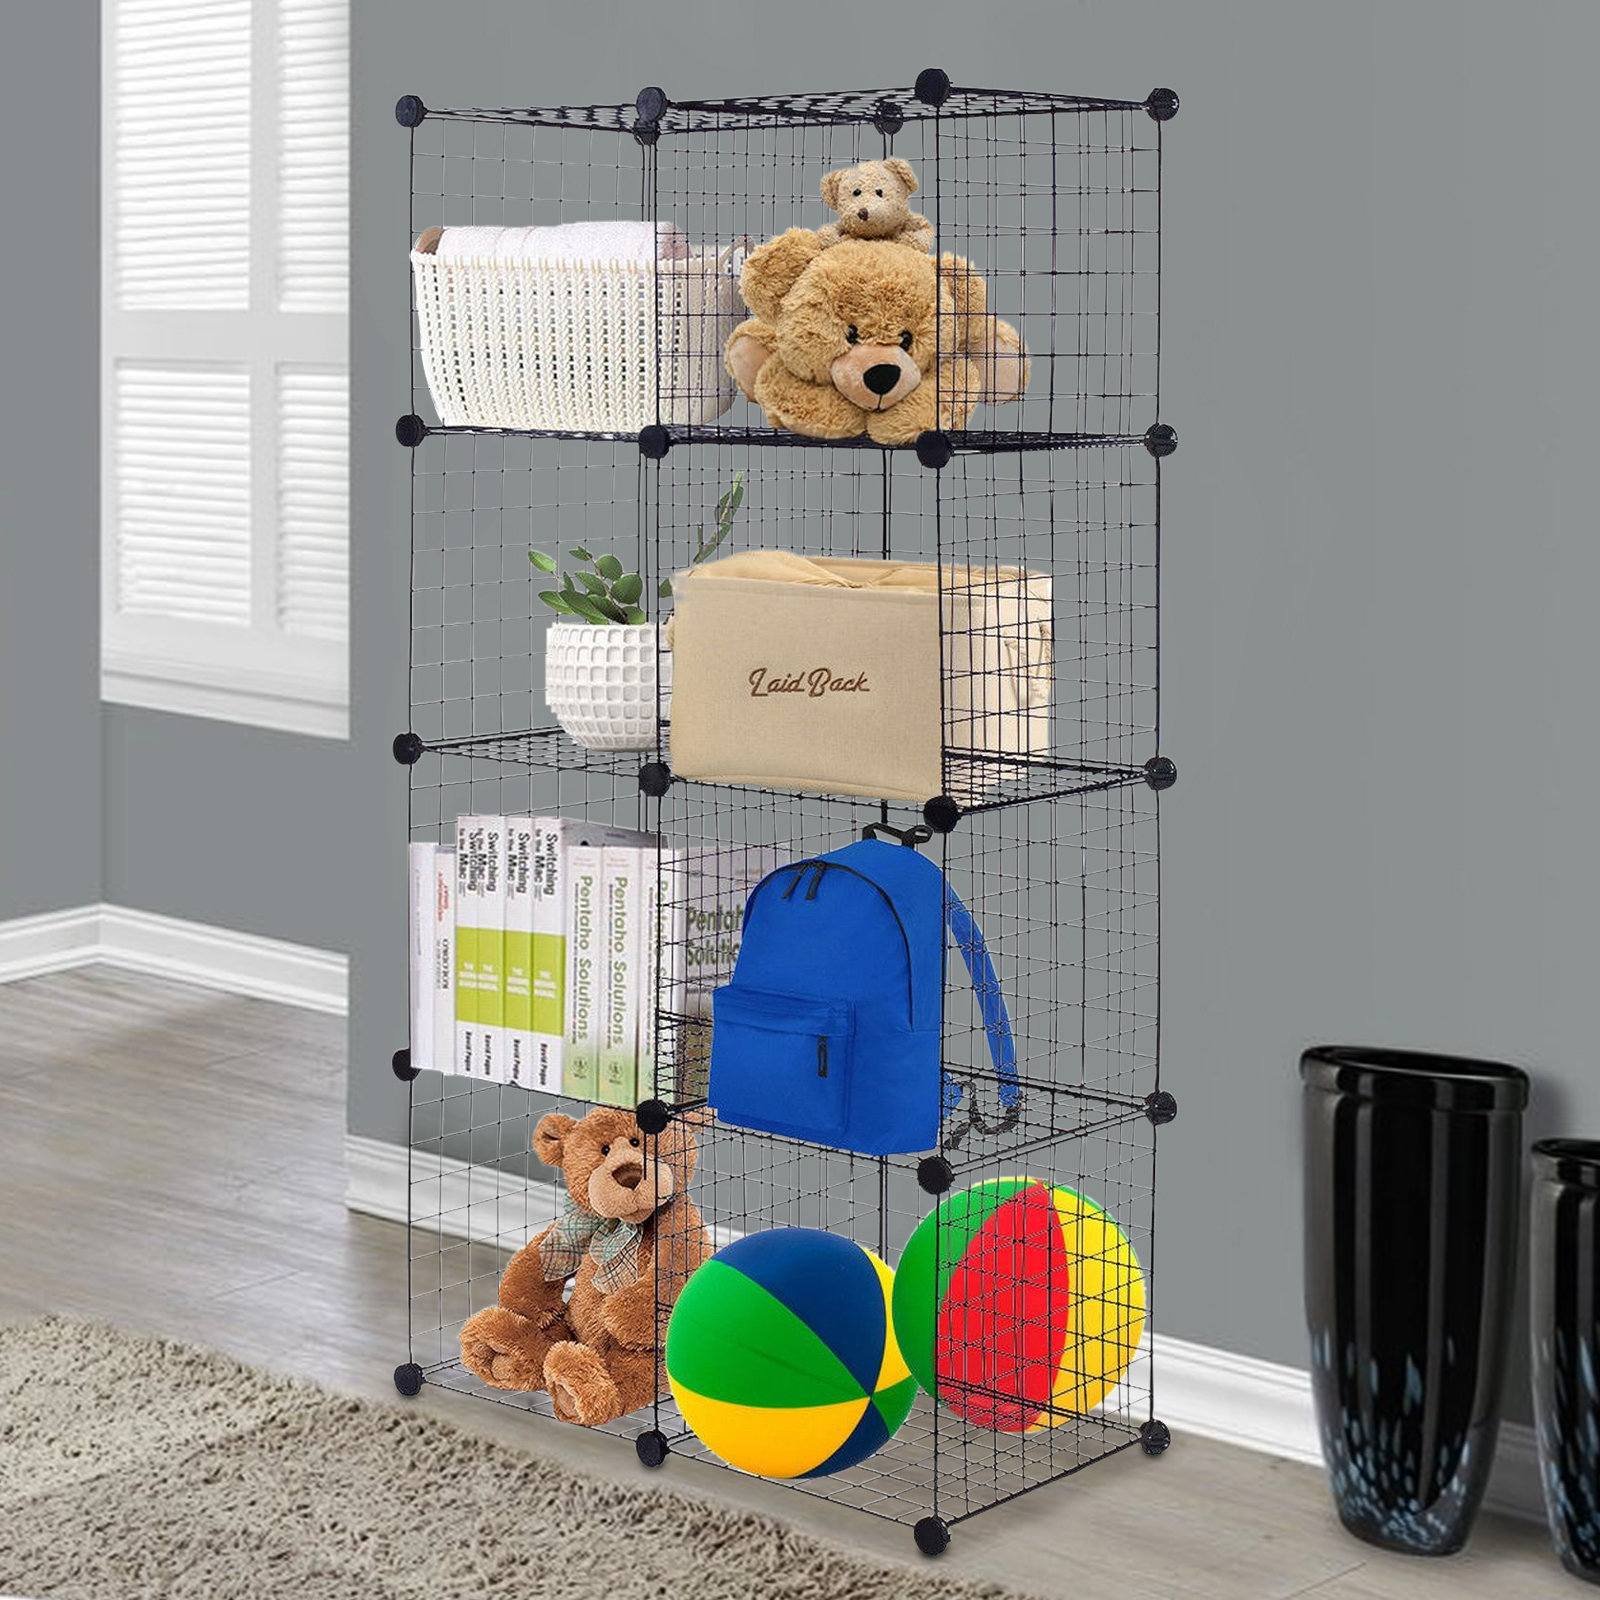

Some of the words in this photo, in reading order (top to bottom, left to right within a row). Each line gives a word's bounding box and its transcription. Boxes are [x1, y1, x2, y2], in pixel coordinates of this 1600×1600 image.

[748, 667, 806, 697] Laid
[807, 667, 871, 698] Back
[459, 853, 468, 880] Mac
[467, 832, 479, 891] Switching
[477, 853, 487, 880] Mac
[486, 832, 499, 892] Switching
[507, 854, 517, 881] Mac
[516, 832, 531, 894] Switching
[534, 855, 546, 884] Mac
[543, 833, 558, 896] Switching
[579, 876, 593, 950] Pentaho
[613, 876, 628, 953] Pentaho
[687, 903, 744, 932] Pentah
[687, 938, 740, 966] Solutio
[578, 959, 593, 1040] Solutions
[612, 960, 628, 1045] Solutions
